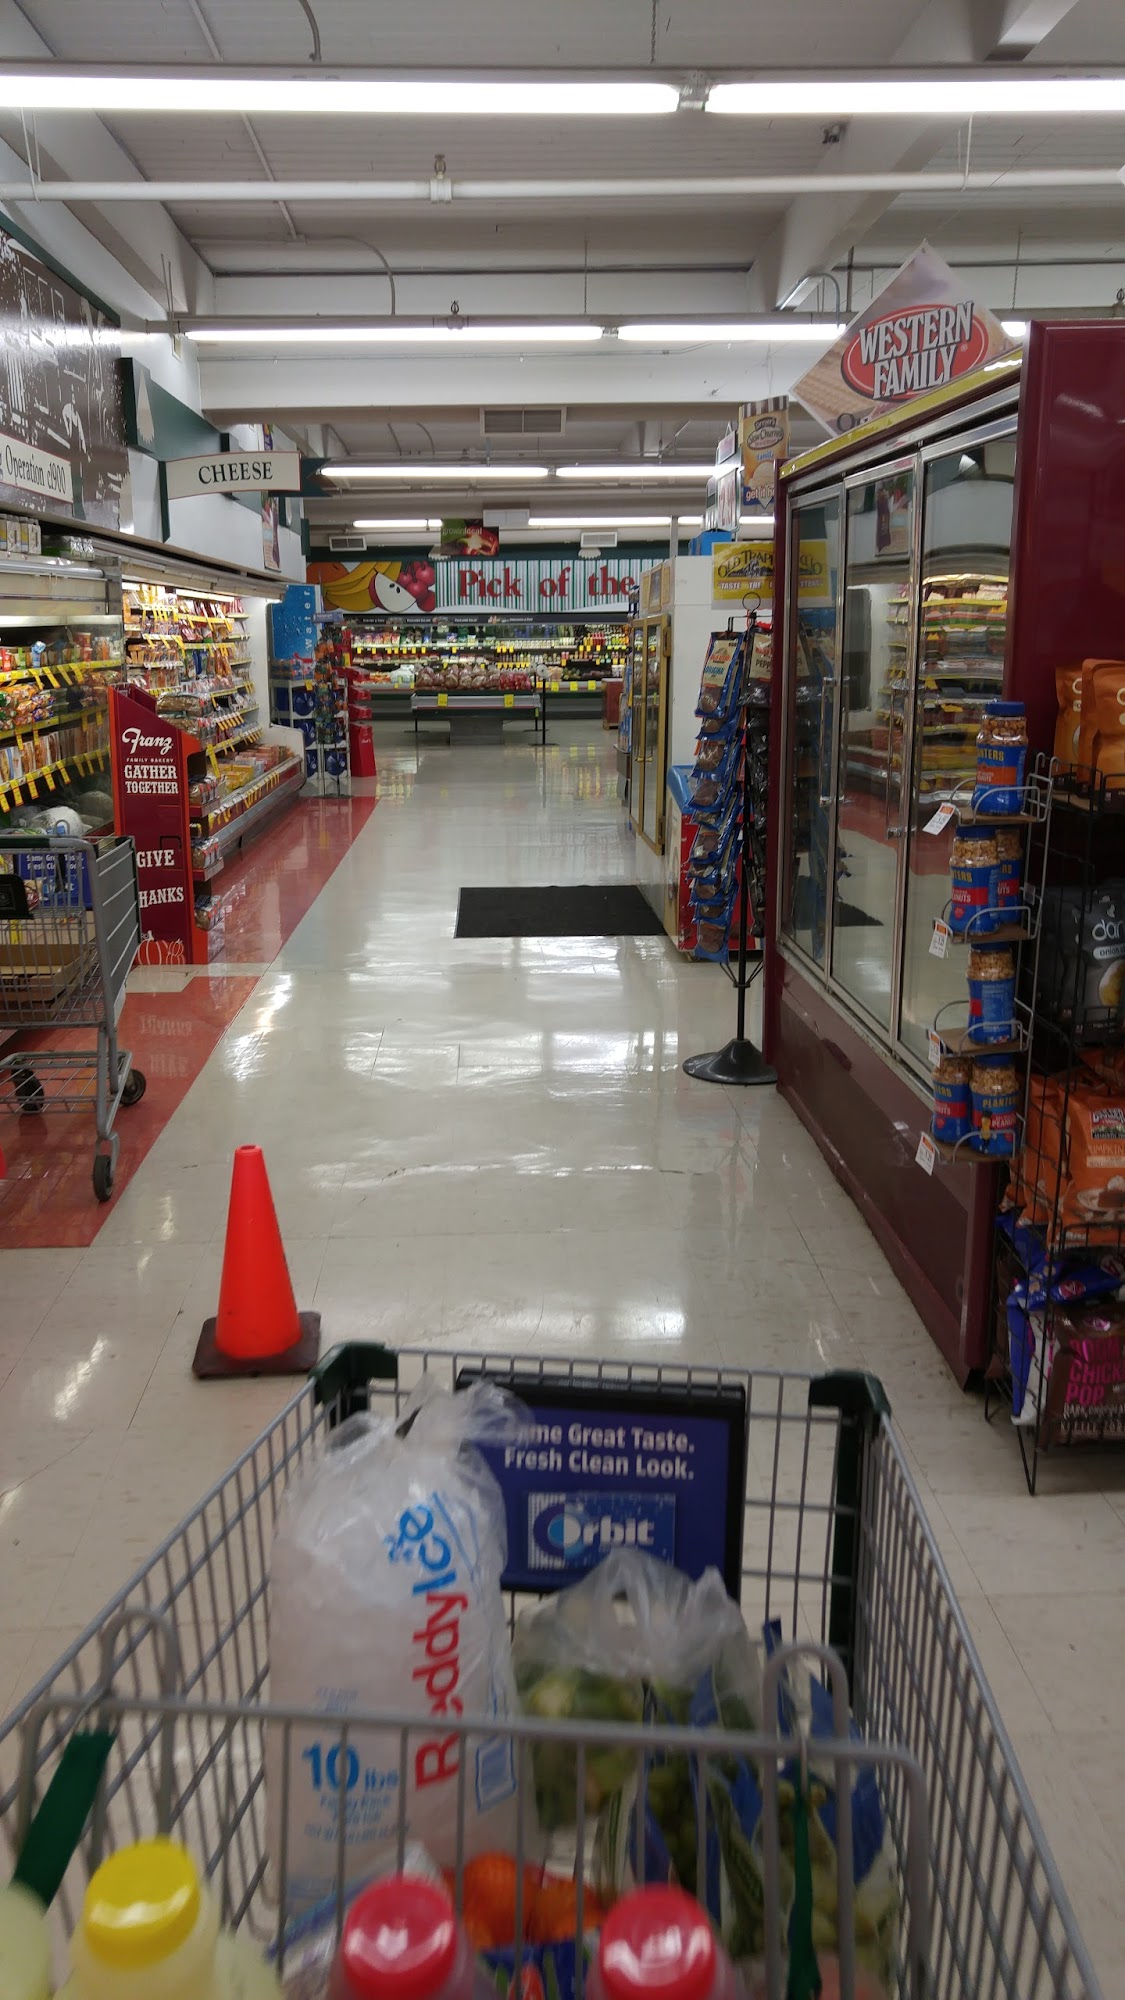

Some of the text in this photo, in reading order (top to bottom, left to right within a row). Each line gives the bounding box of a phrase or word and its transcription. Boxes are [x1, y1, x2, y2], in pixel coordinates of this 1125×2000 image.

[859, 301, 975, 365] WESTERN
[872, 345, 958, 399] FAMILY
[6, 445, 45, 486] Operation
[198, 461, 273, 485] CHEESE
[745, 487, 758, 502] get
[458, 565, 635, 597] Pick of the
[718, 557, 741, 578] OLD
[121, 727, 173, 755] Franz
[124, 764, 177, 780] GATHER
[125, 780, 179, 795] TOGETHER
[136, 850, 175, 868] GIVE
[138, 887, 184, 909] HANKS
[1064, 1383, 1105, 1406] POP
[568, 1422, 626, 1449] Great
[631, 1425, 695, 1454] Taste.
[504, 1447, 695, 1480] Fresh Clean Look.
[540, 1510, 655, 1550] Orbit
[400, 1503, 457, 1596] Ice
[302, 1741, 360, 1792] 10
